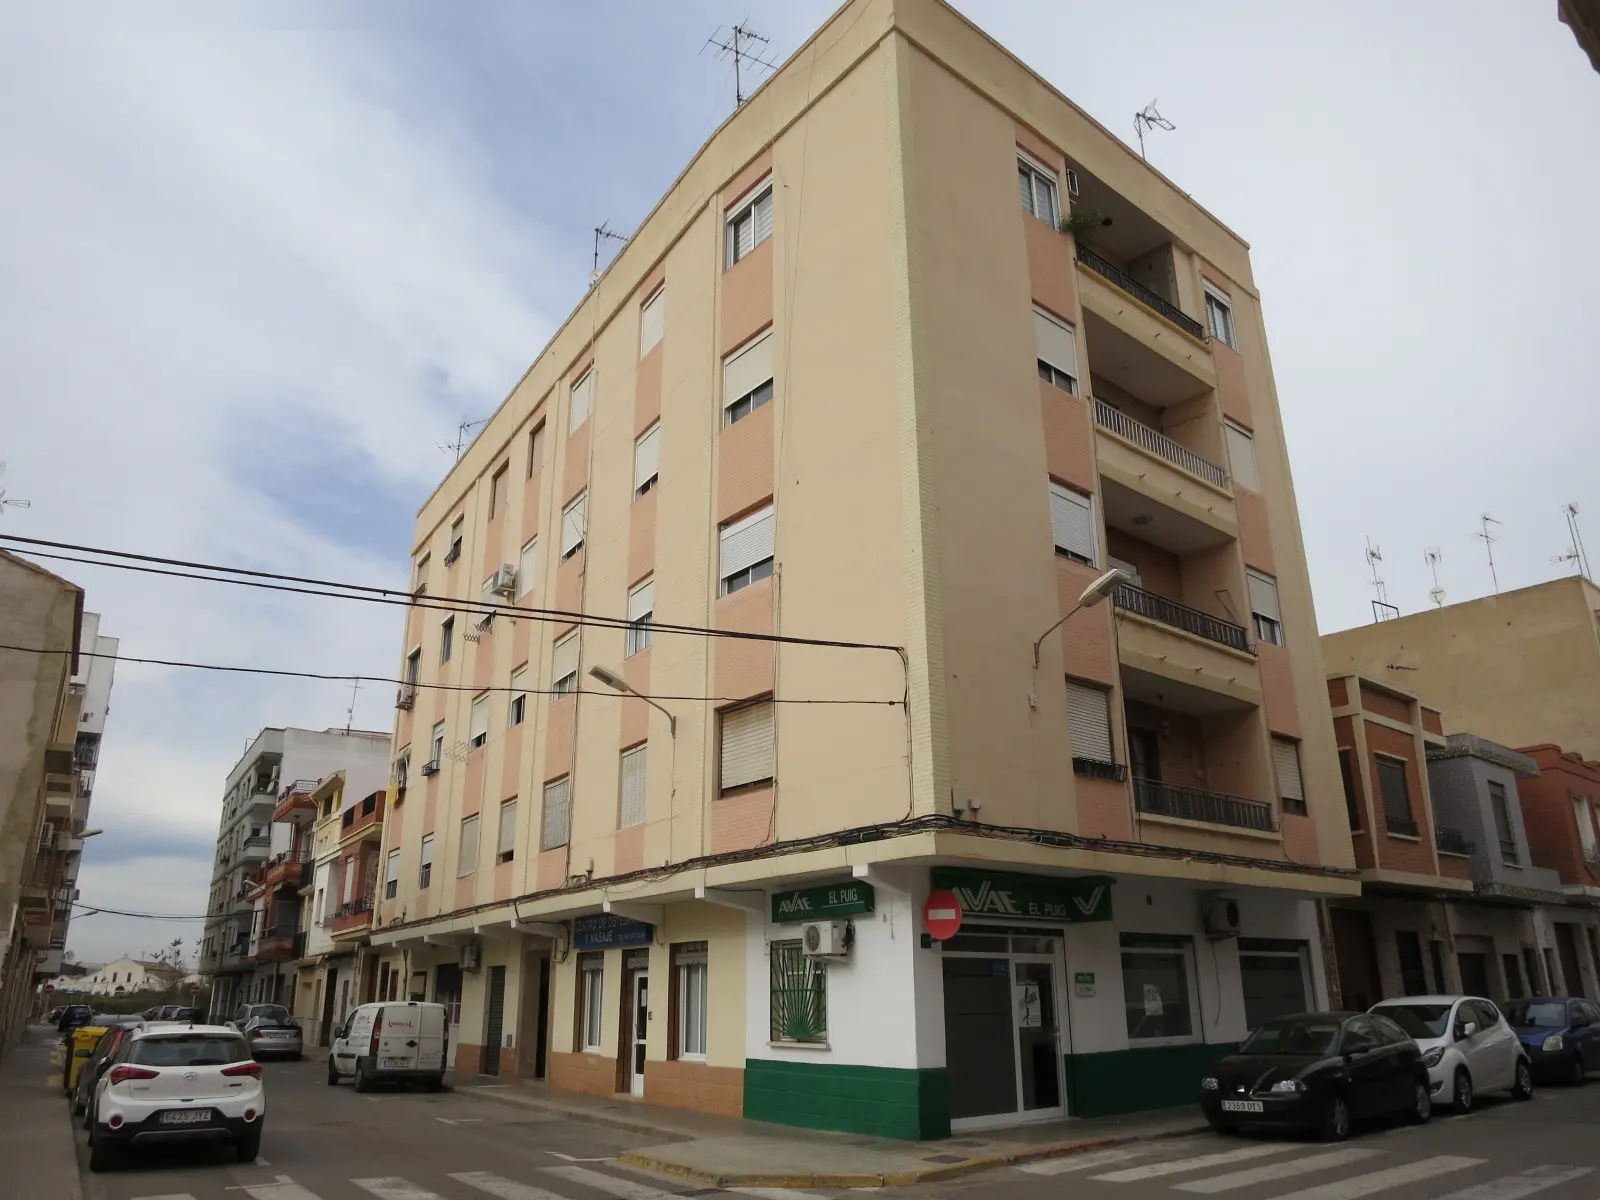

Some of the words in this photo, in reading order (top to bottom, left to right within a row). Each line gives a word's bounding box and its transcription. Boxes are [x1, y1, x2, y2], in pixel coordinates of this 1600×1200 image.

[779, 891, 812, 913] AVAE
[829, 891, 838, 904] EL
[840, 888, 858, 903] PUIG
[1029, 902, 1041, 916] EL
[1044, 903, 1066, 917] PUIG
[598, 915, 606, 929] DE
[590, 930, 613, 944] MASAJE
[1227, 1102, 1246, 1110] 2369
[165, 1111, 189, 1121] 6425
